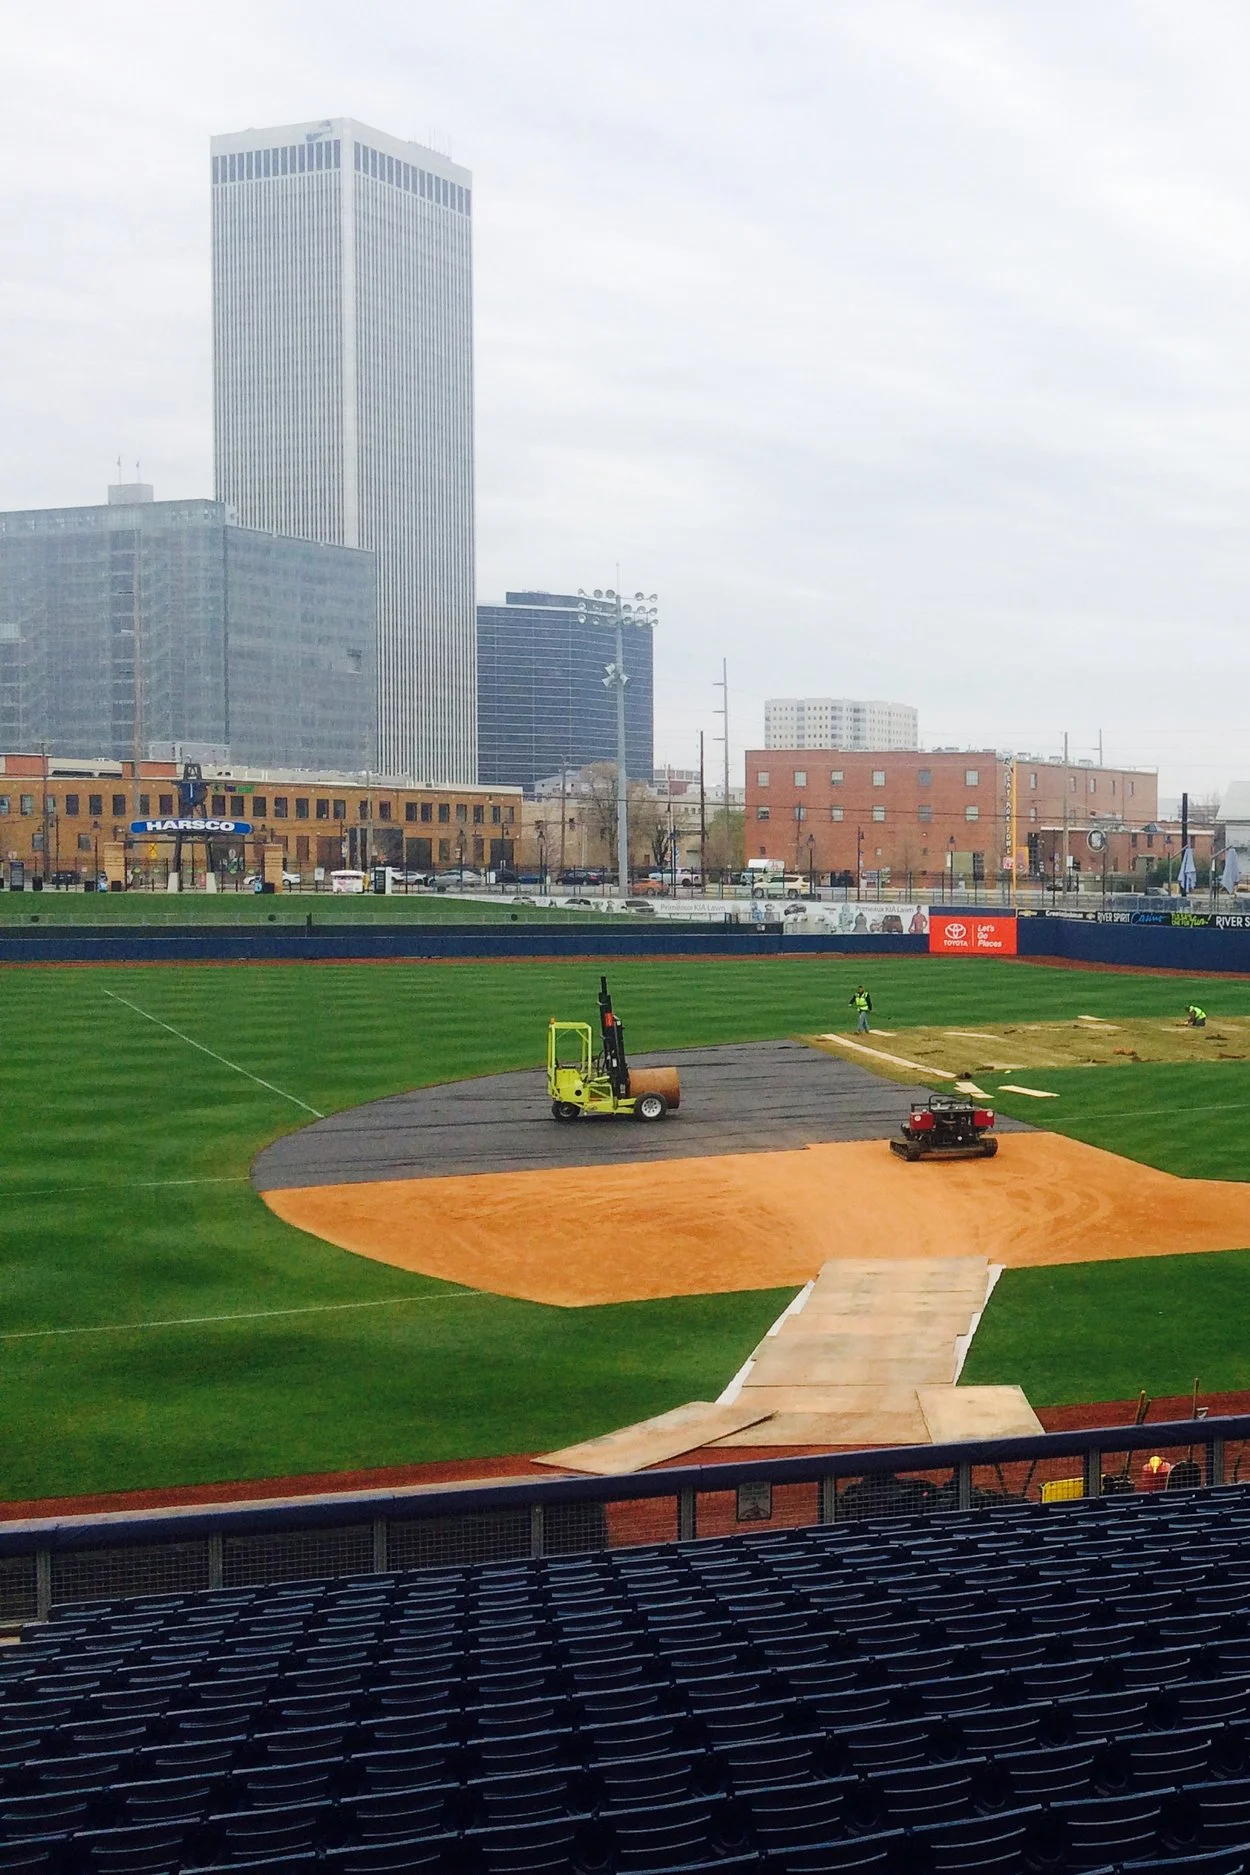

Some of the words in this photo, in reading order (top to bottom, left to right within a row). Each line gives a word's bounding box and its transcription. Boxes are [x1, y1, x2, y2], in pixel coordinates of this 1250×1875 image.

[146, 820, 235, 832] HARSCO
[1097, 911, 1113, 924] RIVER
[1113, 911, 1131, 924] SPIRIT
[1131, 911, 1168, 925] Casino
[1215, 915, 1243, 930] RIVER
